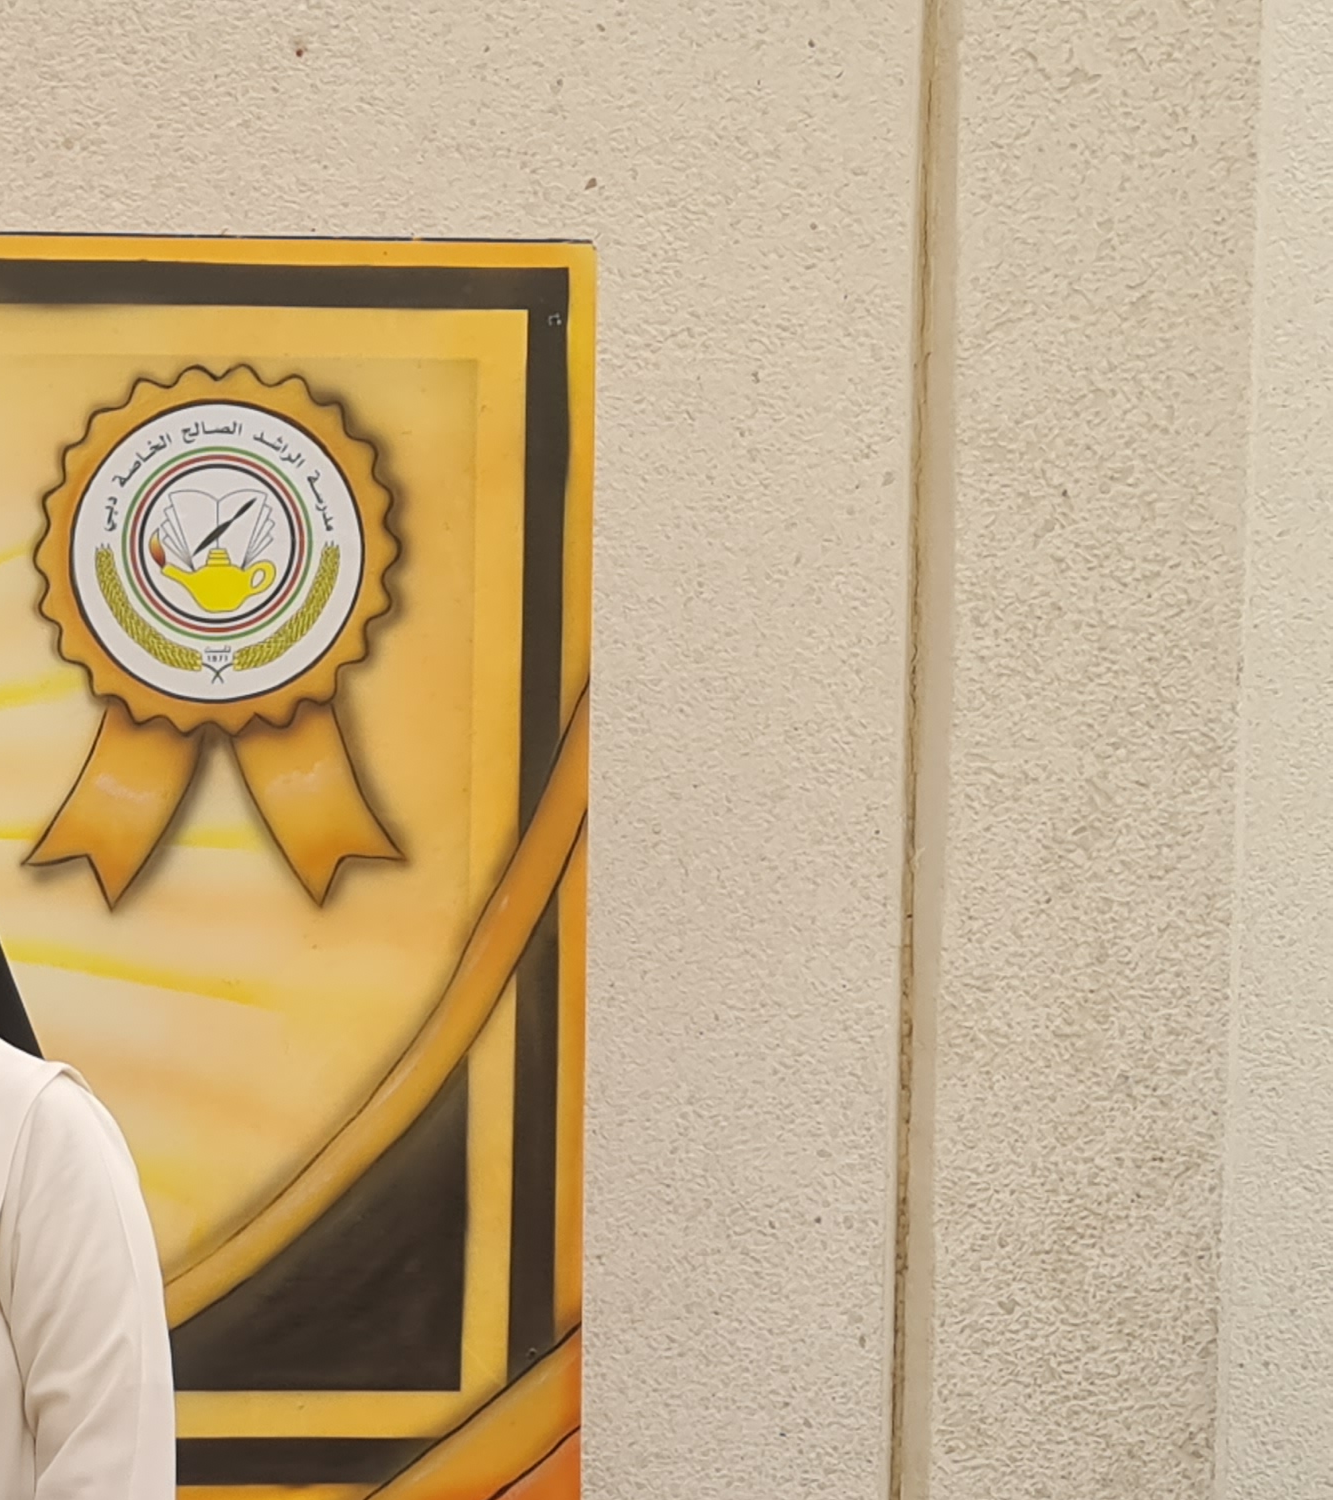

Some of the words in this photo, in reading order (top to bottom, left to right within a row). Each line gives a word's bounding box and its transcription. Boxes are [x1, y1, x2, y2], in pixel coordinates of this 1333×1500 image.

[181, 420, 243, 444] الصالح
[253, 430, 306, 469] الراشد
[111, 432, 172, 488] الخاصة
[104, 496, 118, 532] دبي
[306, 469, 334, 532] مدرسة
